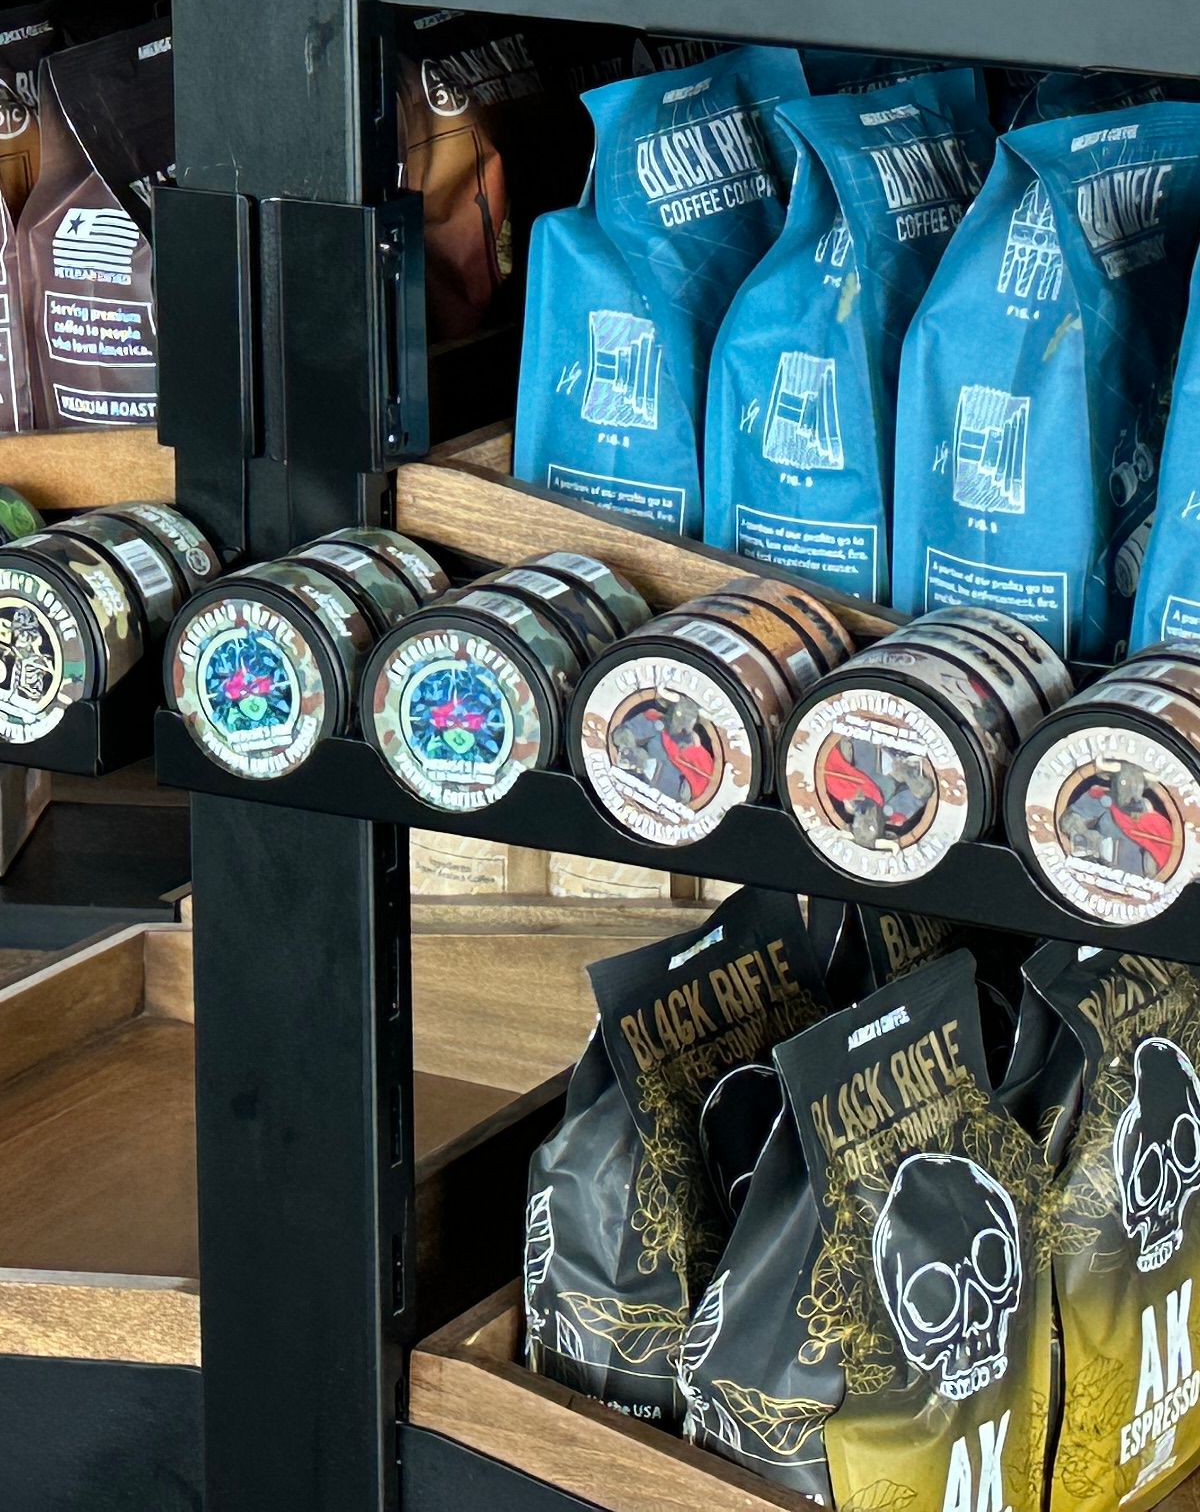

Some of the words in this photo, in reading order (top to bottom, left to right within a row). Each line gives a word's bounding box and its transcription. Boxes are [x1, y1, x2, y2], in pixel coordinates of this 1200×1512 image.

[636, 124, 724, 200] BLACK
[660, 188, 724, 228] COFFEE
[896, 207, 951, 242] COFFEE
[111, 401, 157, 418] ROAST
[620, 978, 719, 1073] BLACK
[708, 938, 800, 1024] RIFLE
[811, 1061, 896, 1163] BLACK
[890, 1018, 969, 1109] RIFLE
[1134, 1278, 1193, 1417] AK
[633, 1402, 662, 1420] USA
[1119, 1369, 1200, 1466] ESPRESSO
[941, 1408, 1012, 1512] AK
